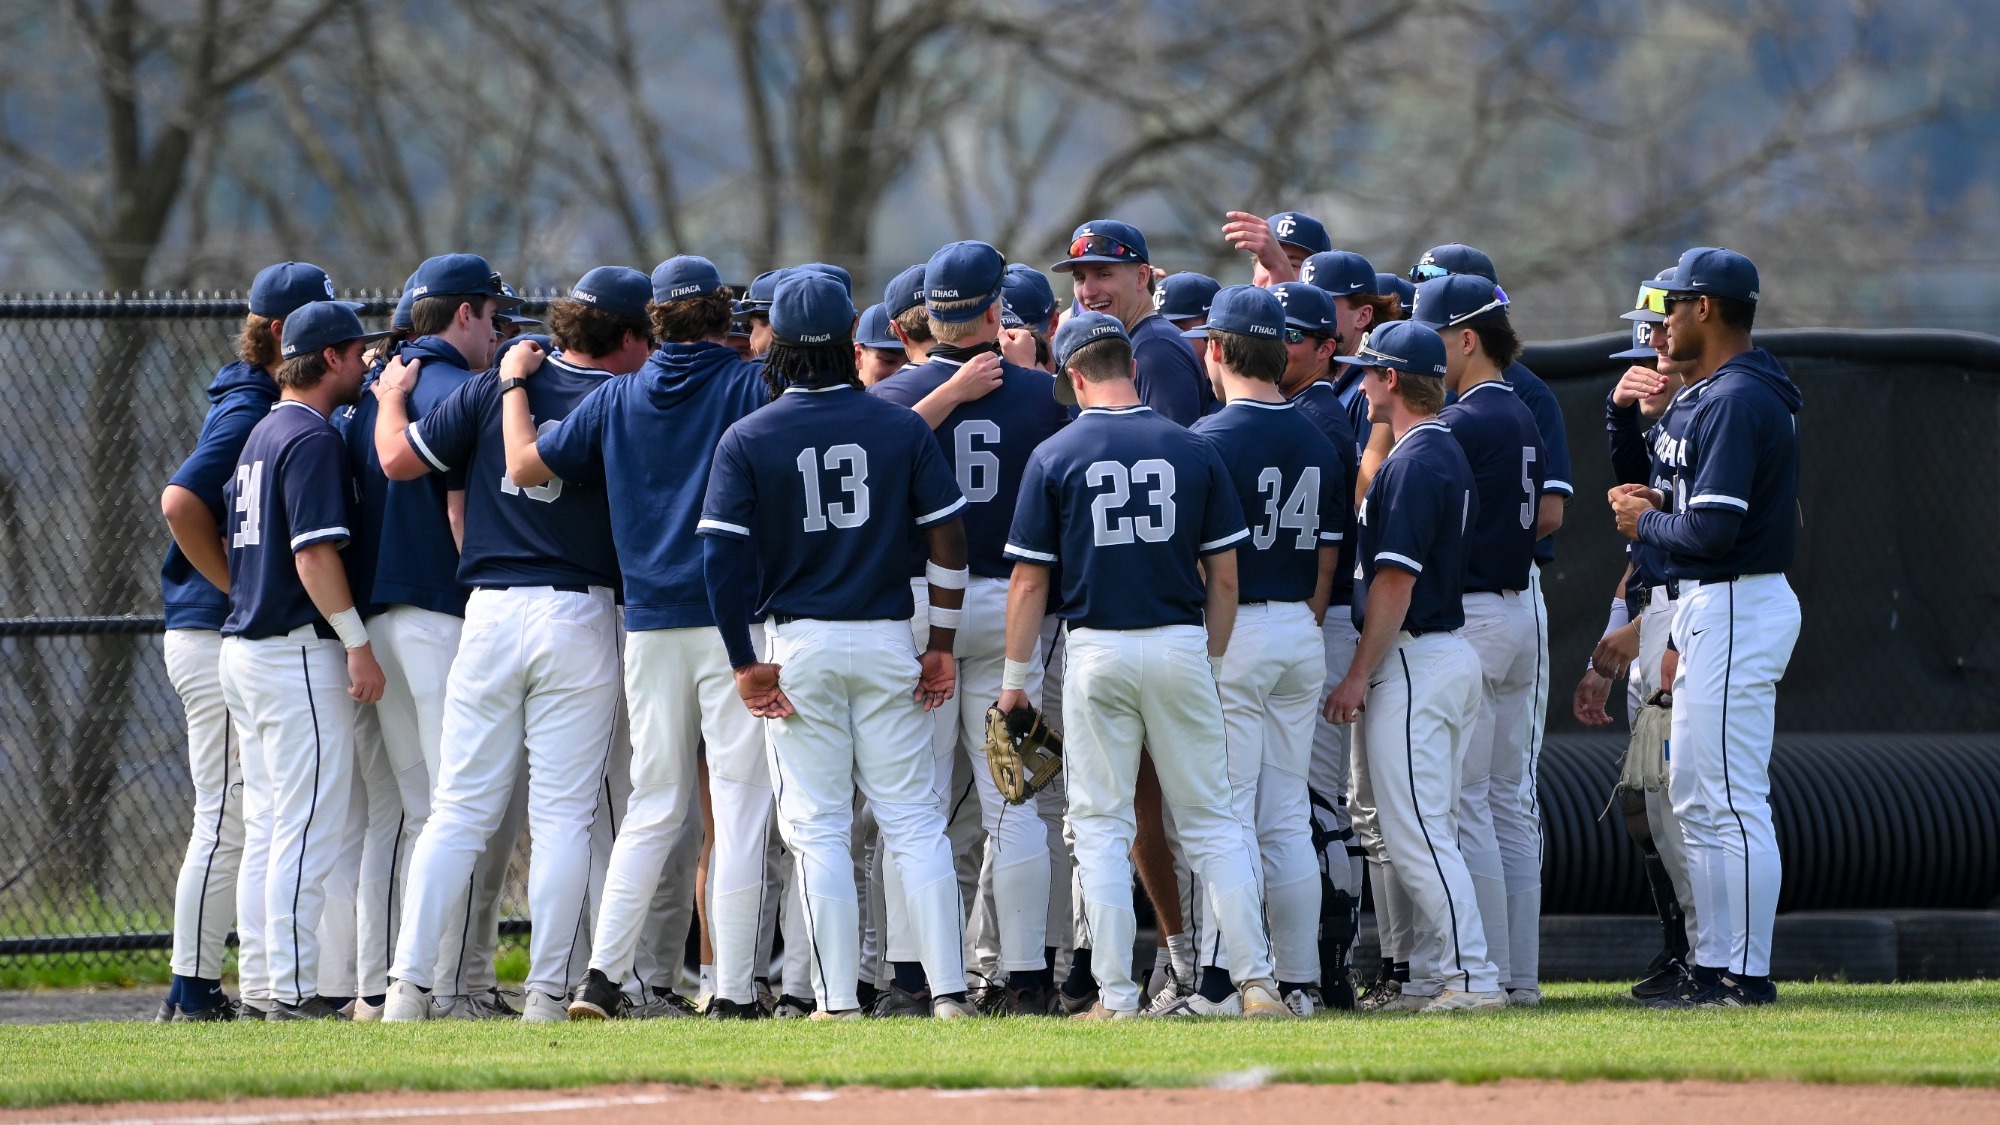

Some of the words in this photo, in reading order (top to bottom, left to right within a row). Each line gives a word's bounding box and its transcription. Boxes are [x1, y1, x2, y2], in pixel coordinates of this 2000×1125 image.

[574, 290, 597, 304] ITHACA
[671, 284, 701, 298] ITHACA
[931, 289, 959, 298] ITHACA
[1092, 325, 1120, 336] ITHACA
[1249, 324, 1277, 336] ITHACA
[800, 332, 831, 343] ITHACA
[953, 419, 1000, 503] 6
[796, 443, 870, 532] 13
[1519, 446, 1537, 530] 5
[1085, 458, 1176, 547] 23
[1252, 466, 1321, 551] 34
